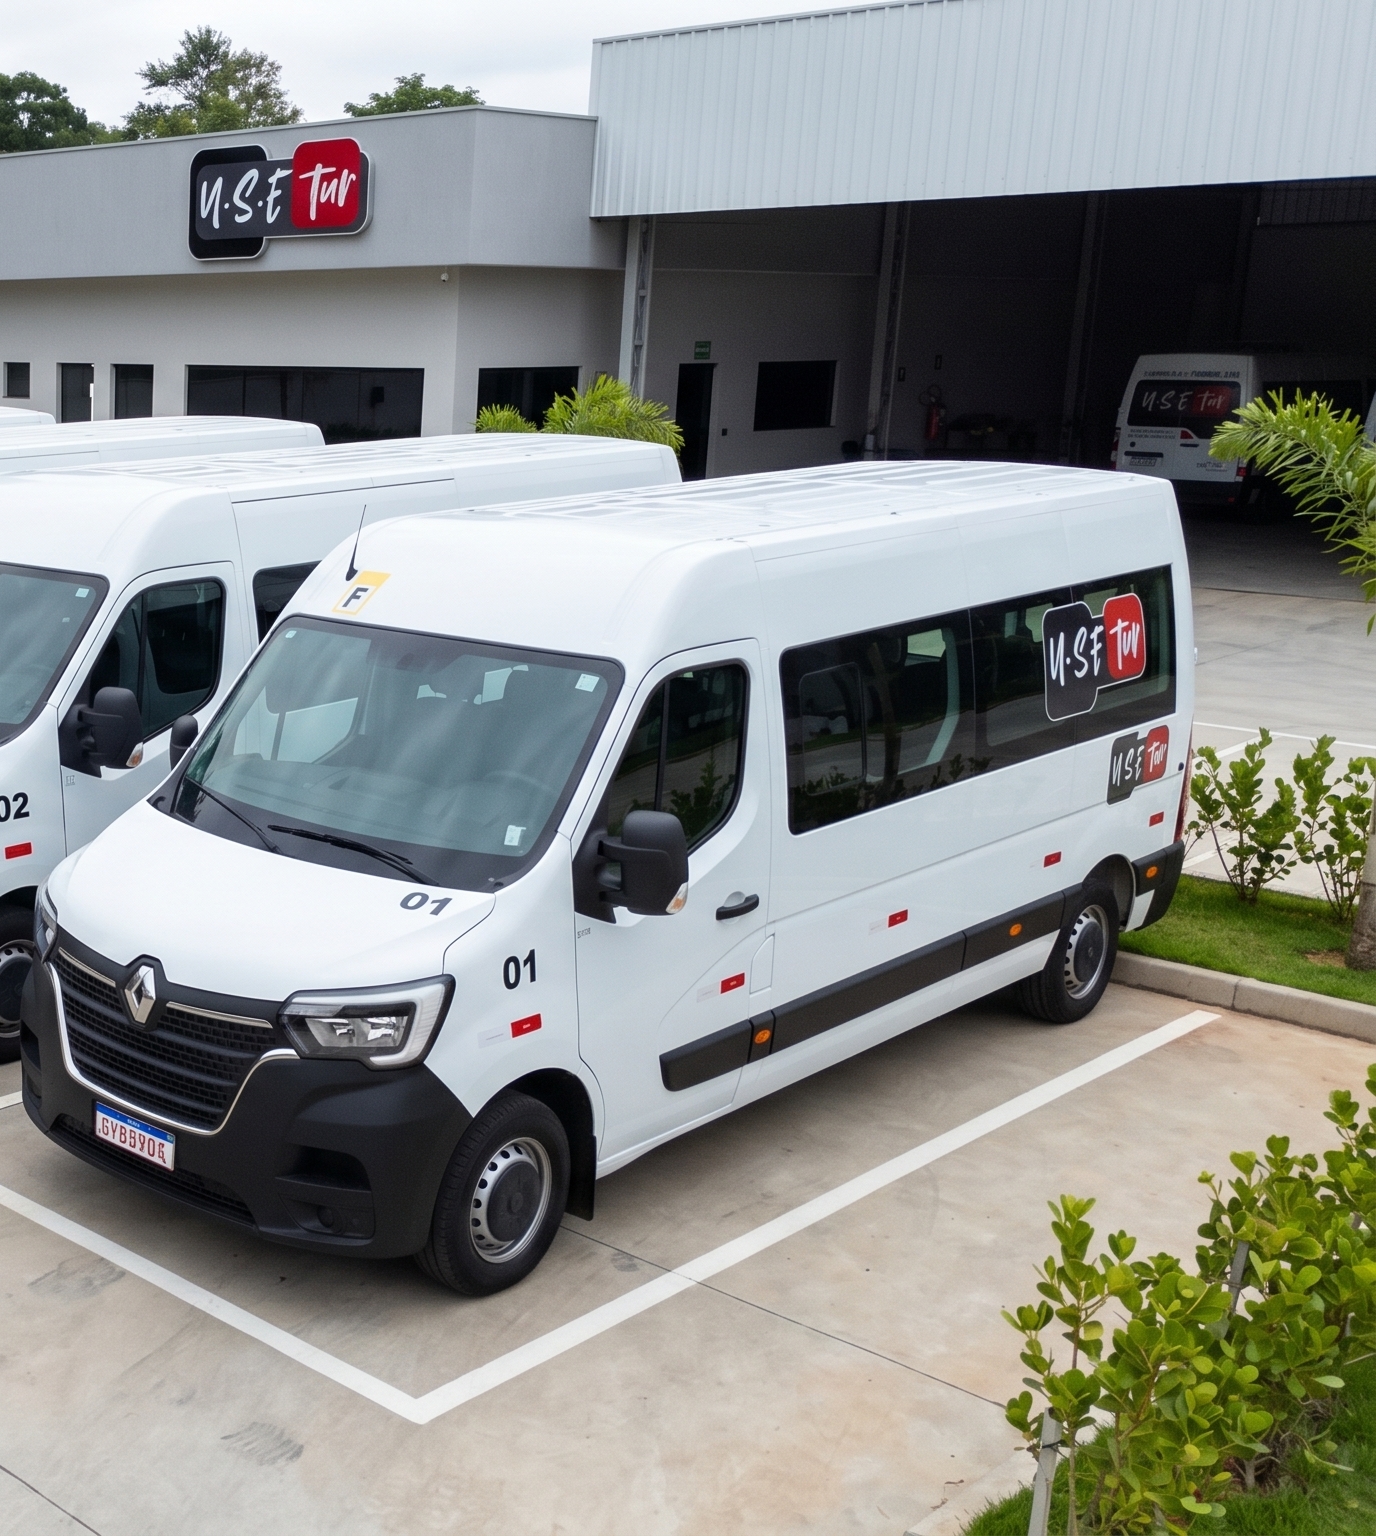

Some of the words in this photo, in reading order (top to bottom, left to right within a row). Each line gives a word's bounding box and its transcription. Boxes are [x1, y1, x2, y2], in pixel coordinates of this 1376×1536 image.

[299, 163, 356, 221] Tur
[342, 587, 369, 607] F
[399, 892, 453, 916] 01
[503, 948, 537, 990] 01
